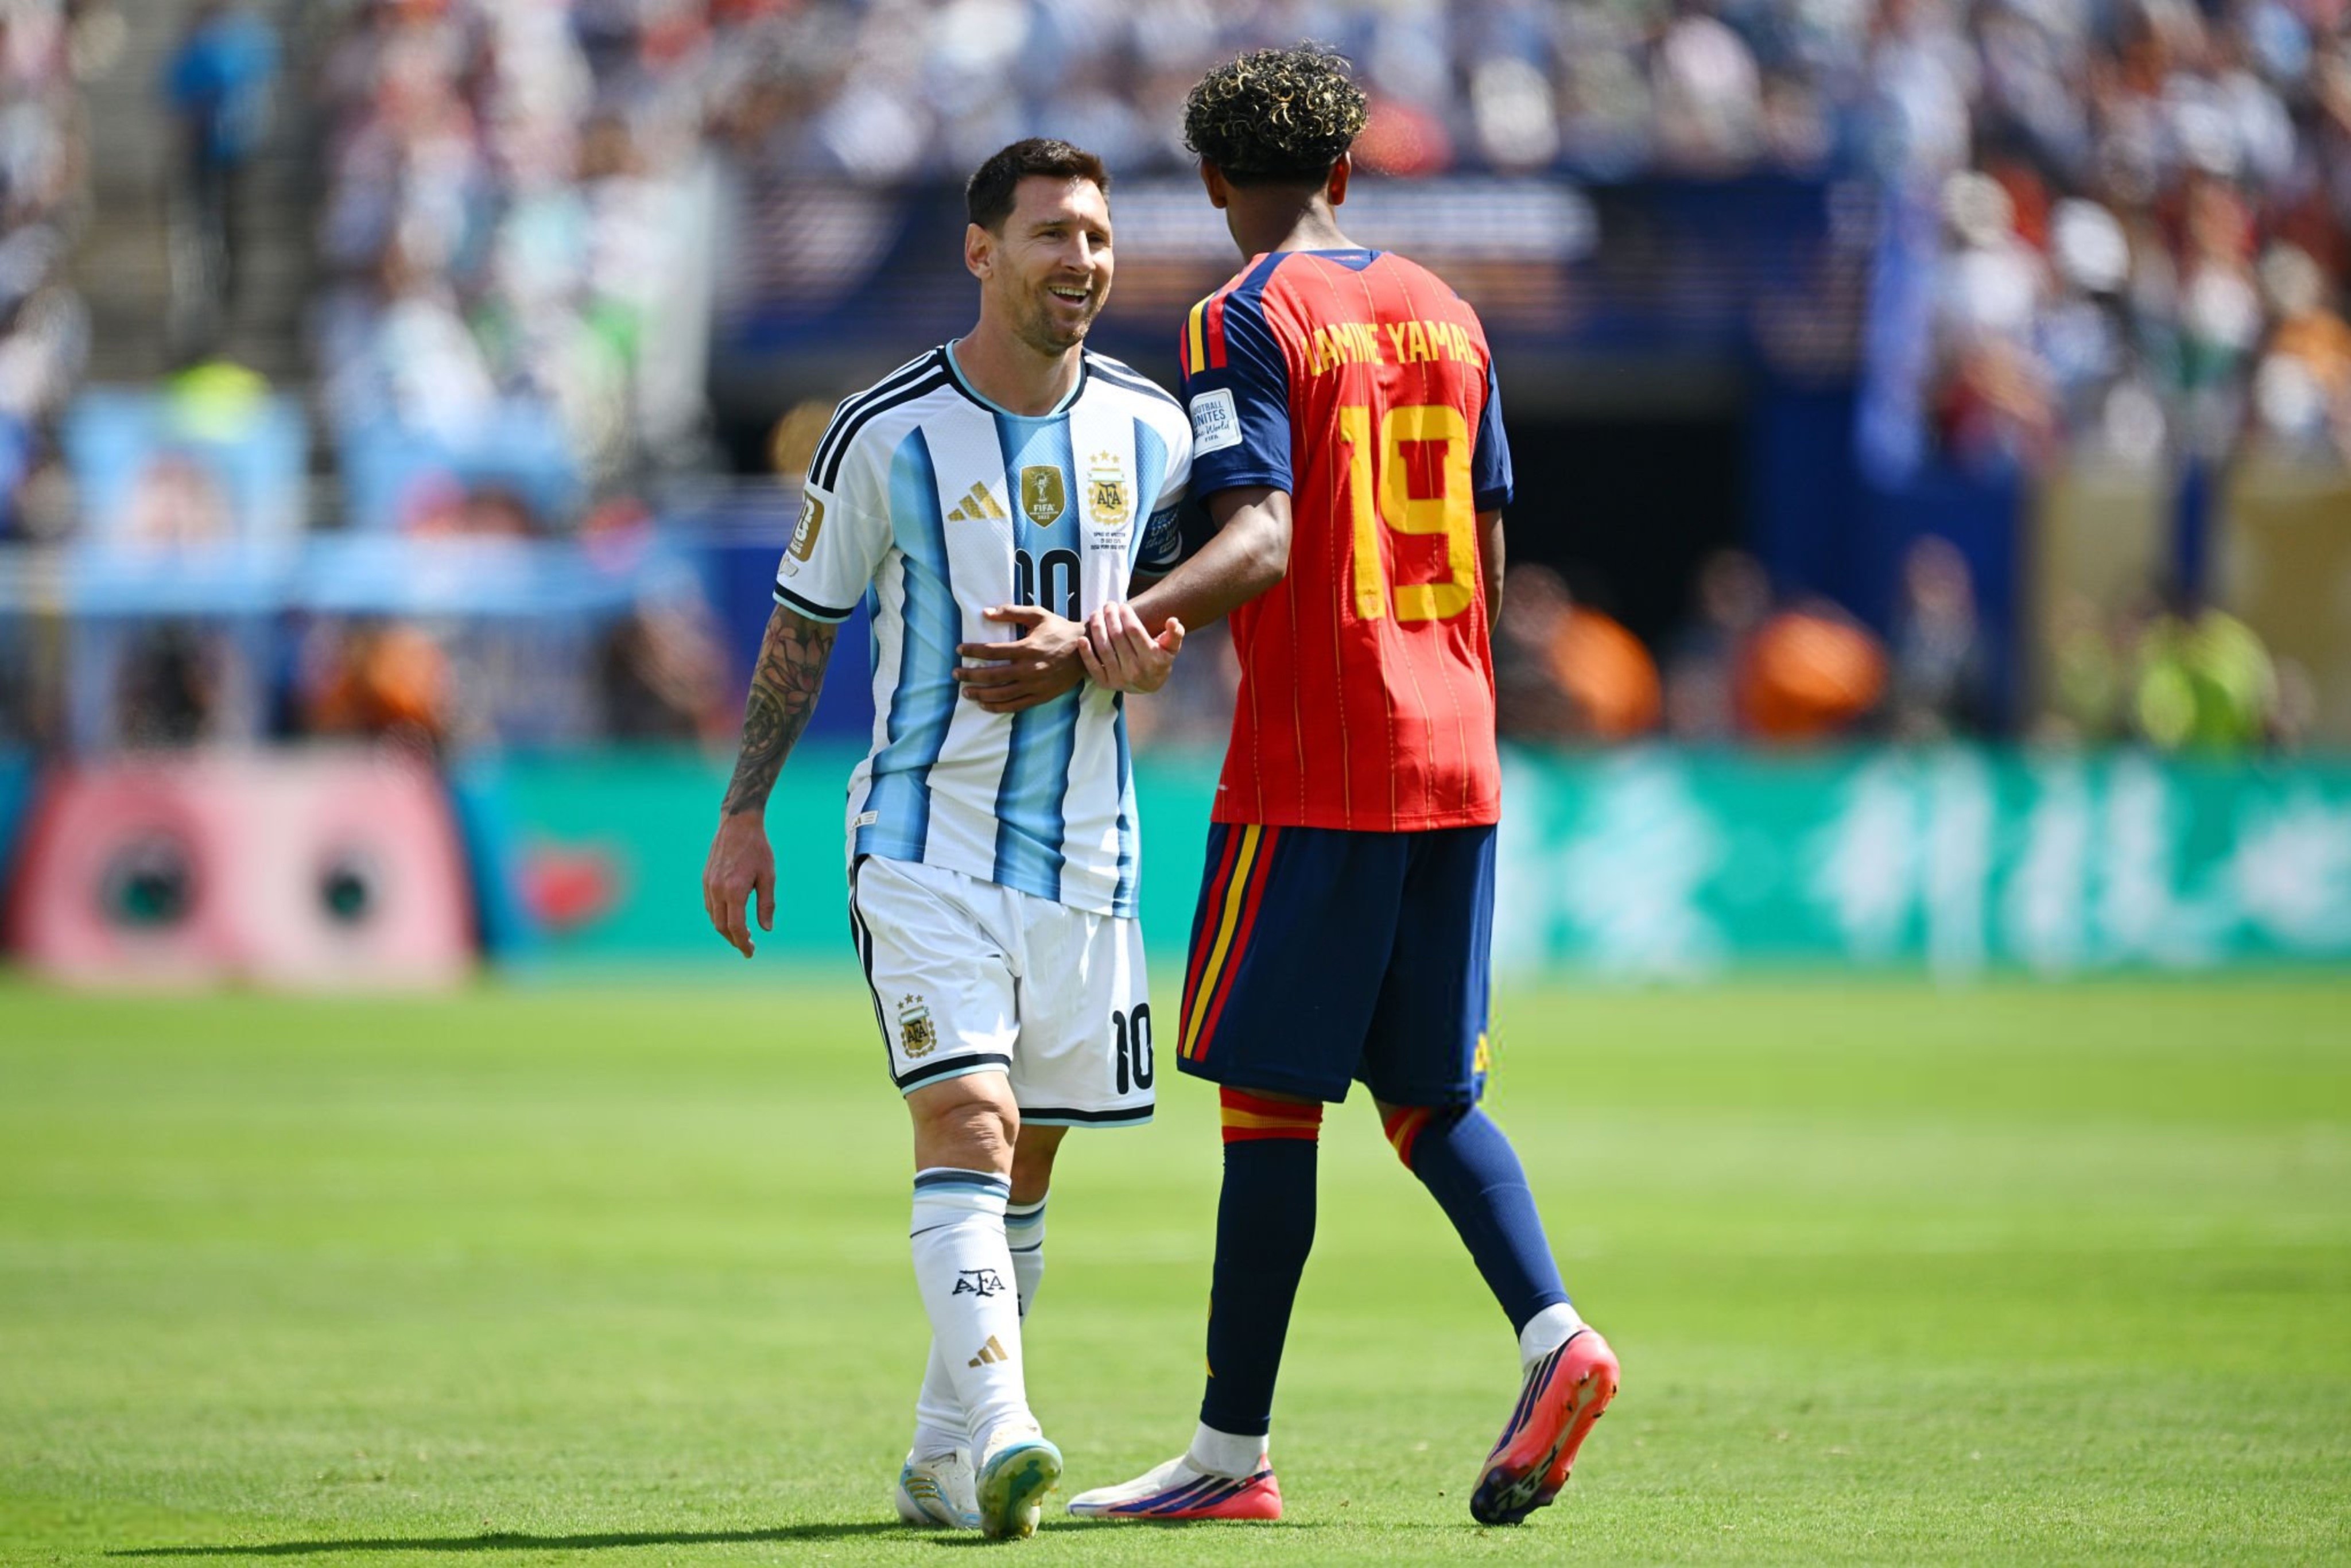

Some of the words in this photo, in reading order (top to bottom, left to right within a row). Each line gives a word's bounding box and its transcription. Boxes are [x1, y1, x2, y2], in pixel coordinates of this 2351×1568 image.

[1386, 320, 1480, 367] YAMAL
[1194, 401, 1223, 414] OTBALL
[1097, 482, 1122, 510] AFA
[1340, 405, 1475, 621] 19
[1015, 549, 1081, 622] 10
[1112, 1003, 1153, 1095] 10
[952, 1269, 1006, 1297] AFA
